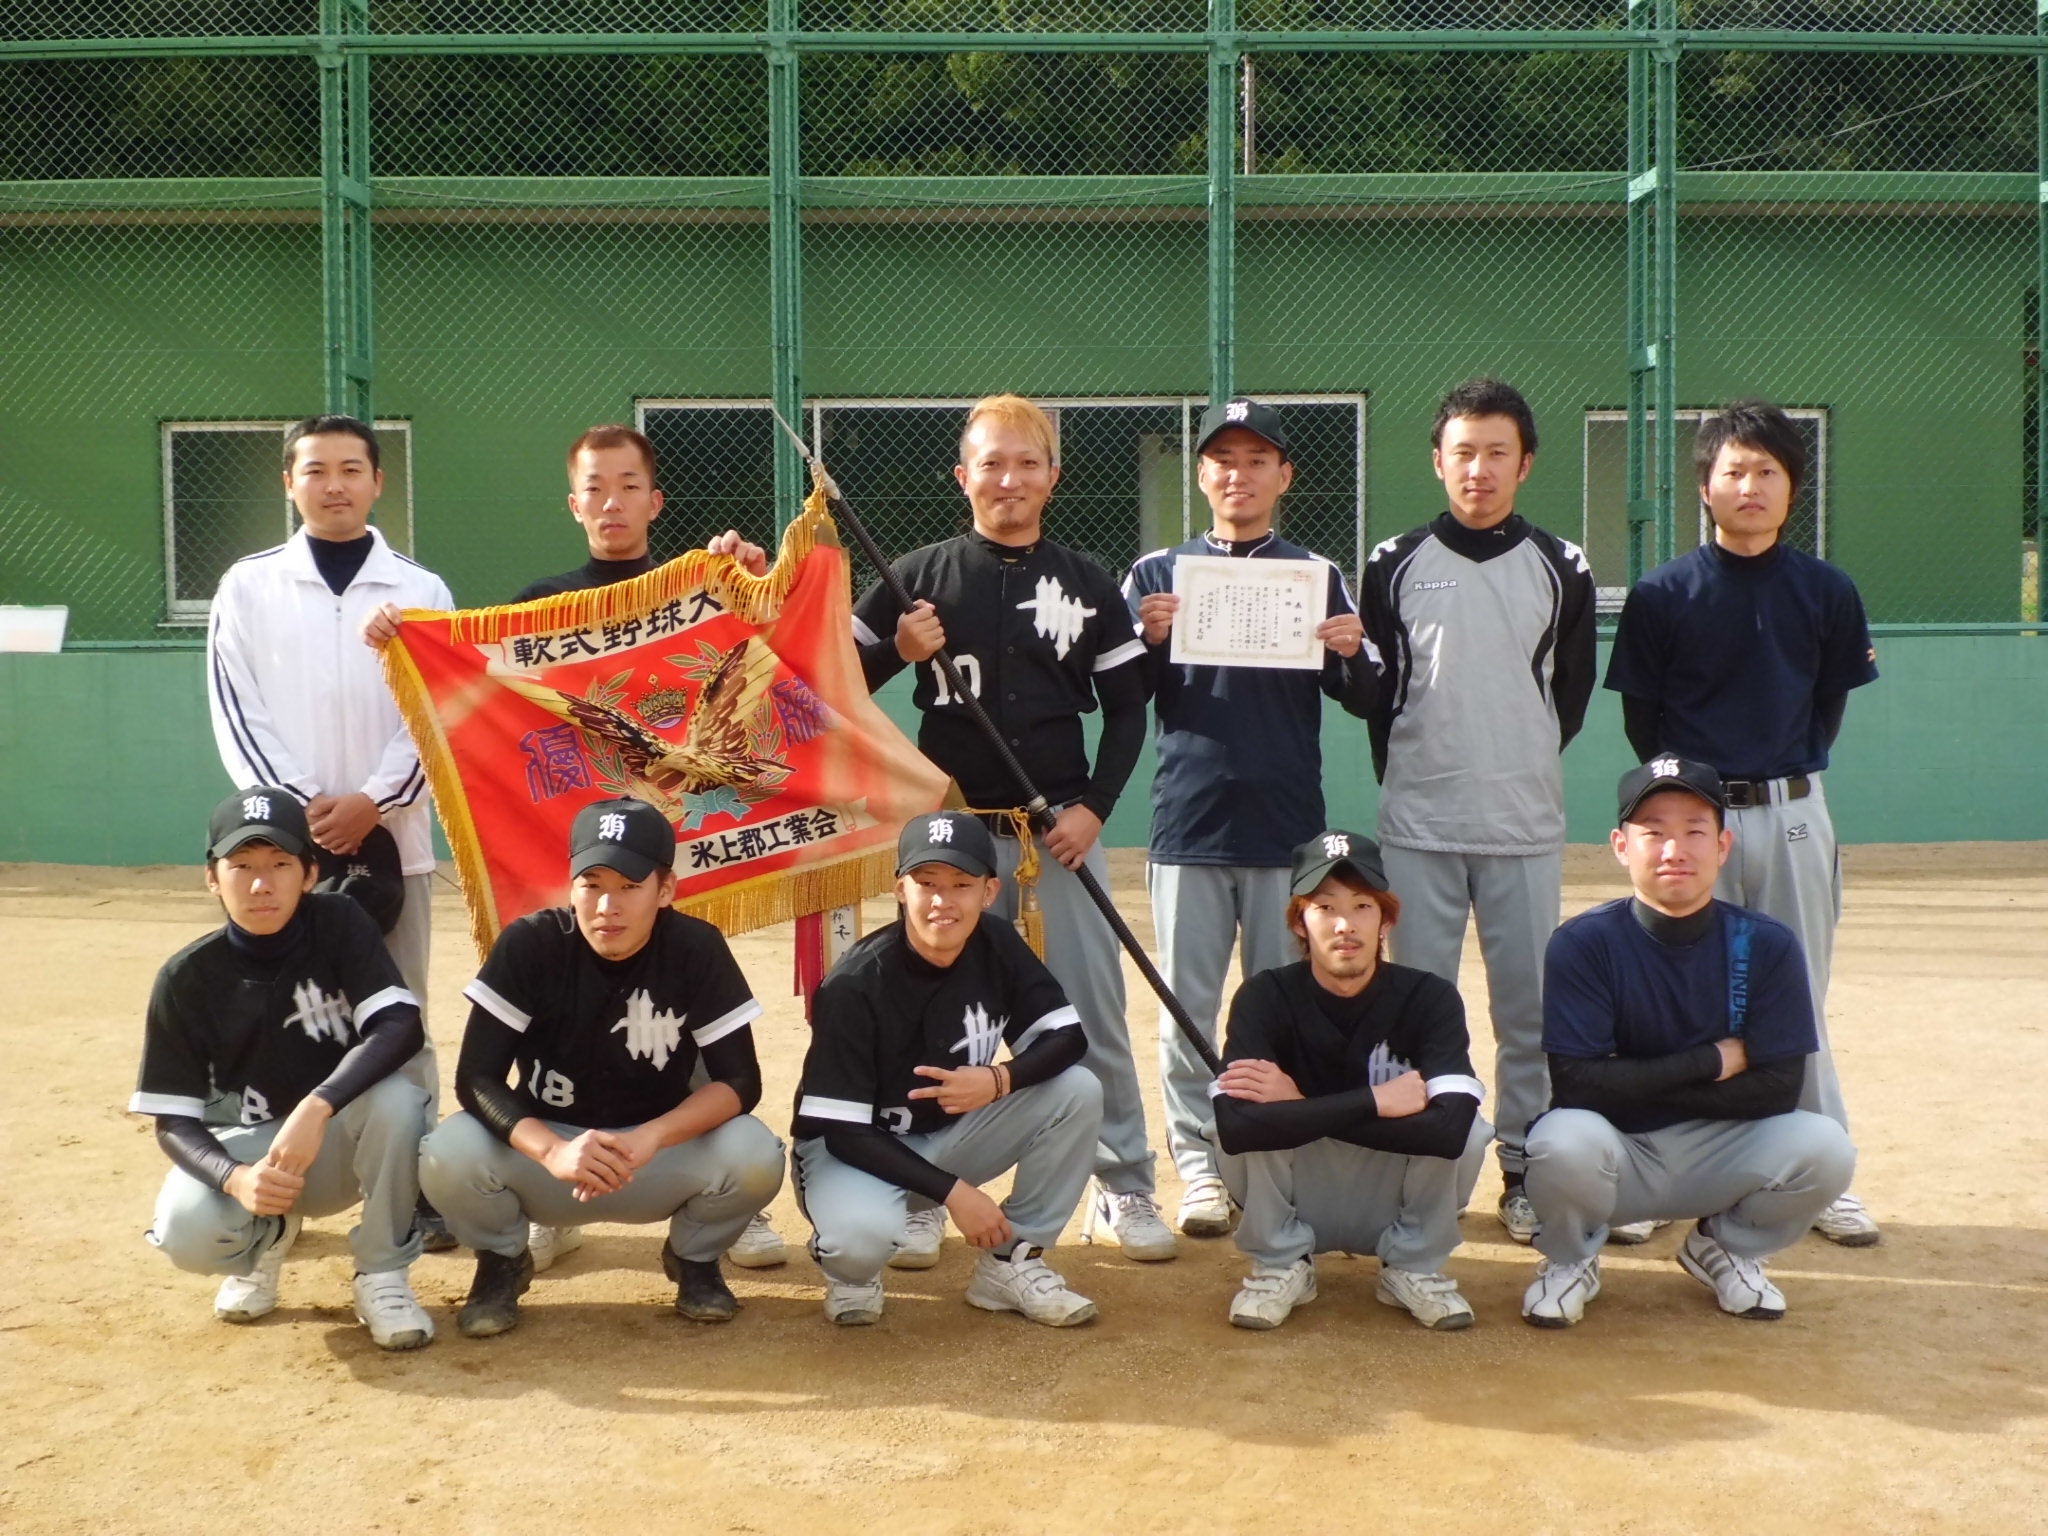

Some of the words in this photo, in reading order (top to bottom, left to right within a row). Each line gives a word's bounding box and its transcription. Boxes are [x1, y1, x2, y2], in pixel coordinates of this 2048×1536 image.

[1414, 579, 1457, 591] Kappa
[931, 654, 981, 706] 10
[528, 1058, 575, 1108] 18
